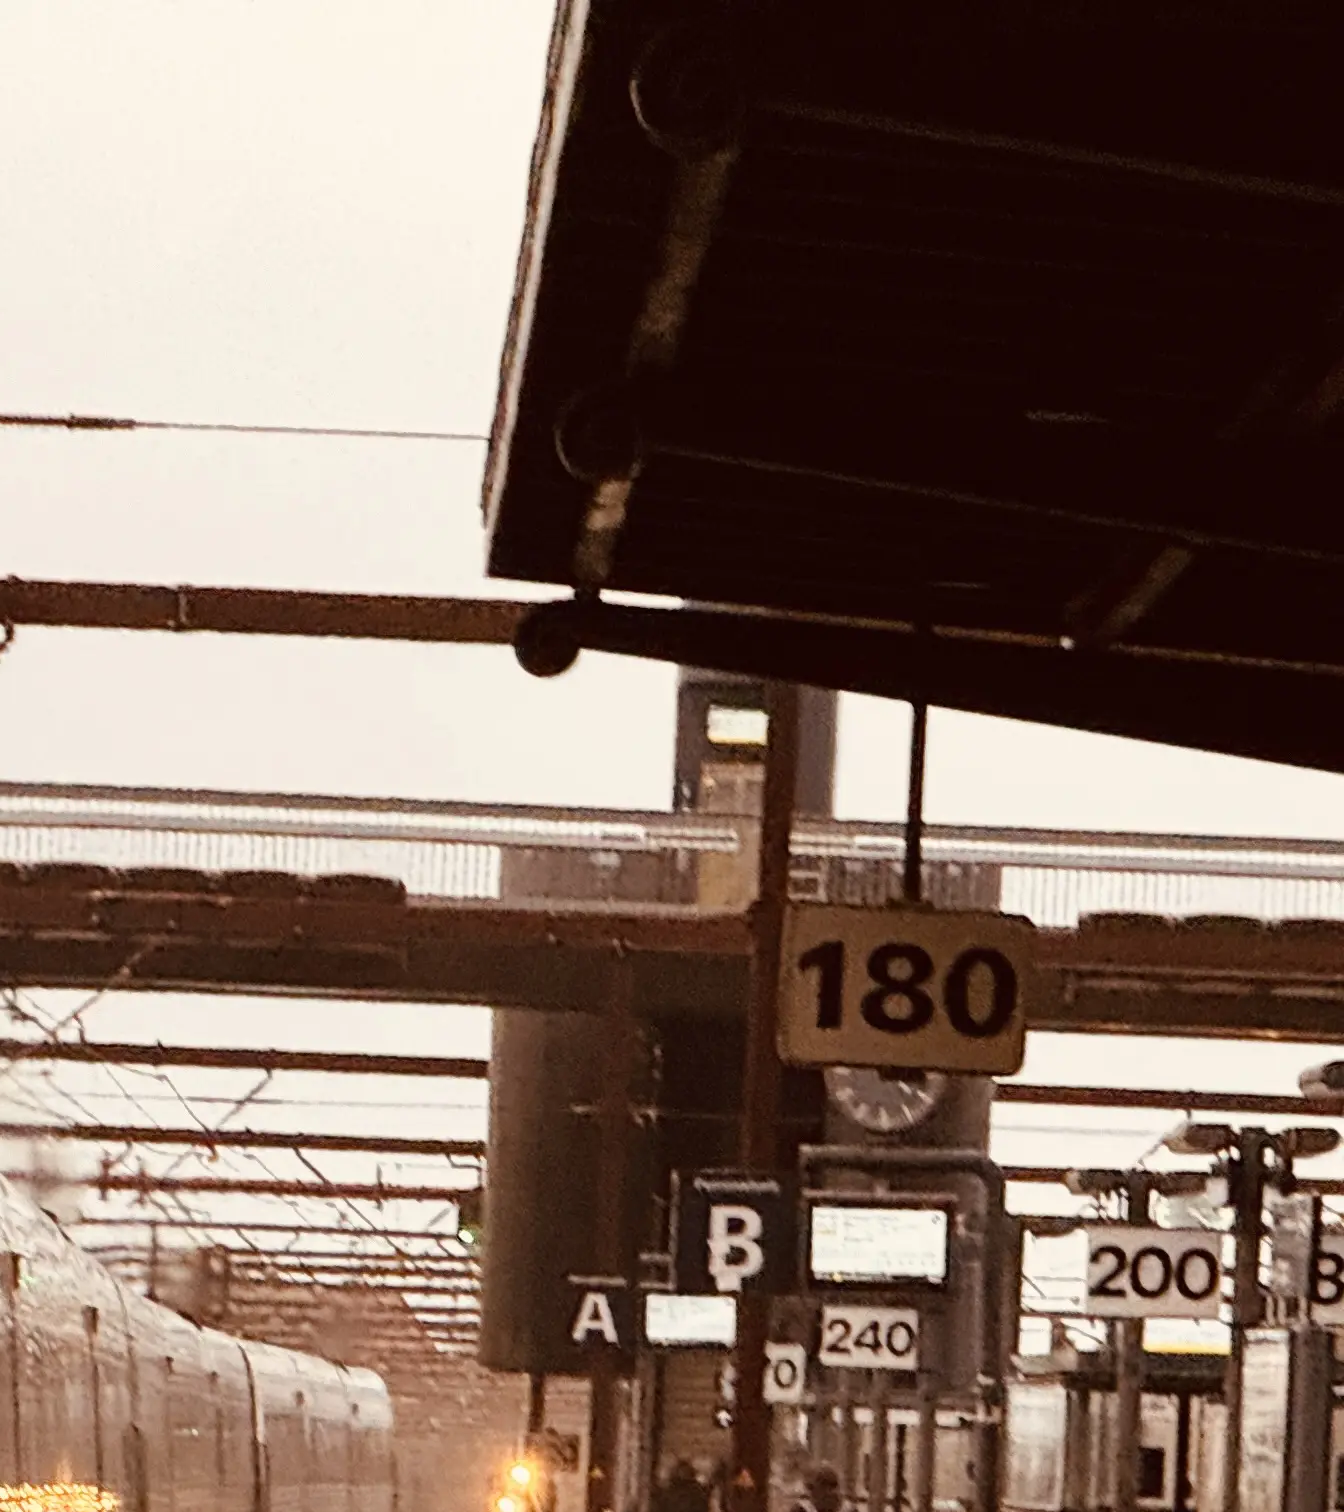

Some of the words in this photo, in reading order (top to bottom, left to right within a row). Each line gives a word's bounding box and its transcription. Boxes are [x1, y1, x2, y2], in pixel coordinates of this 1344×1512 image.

[798, 940, 1018, 1038] 180
[709, 1204, 764, 1278] B
[1088, 1245, 1220, 1300] 200
[572, 1291, 621, 1347] A
[826, 1318, 914, 1357] 240
